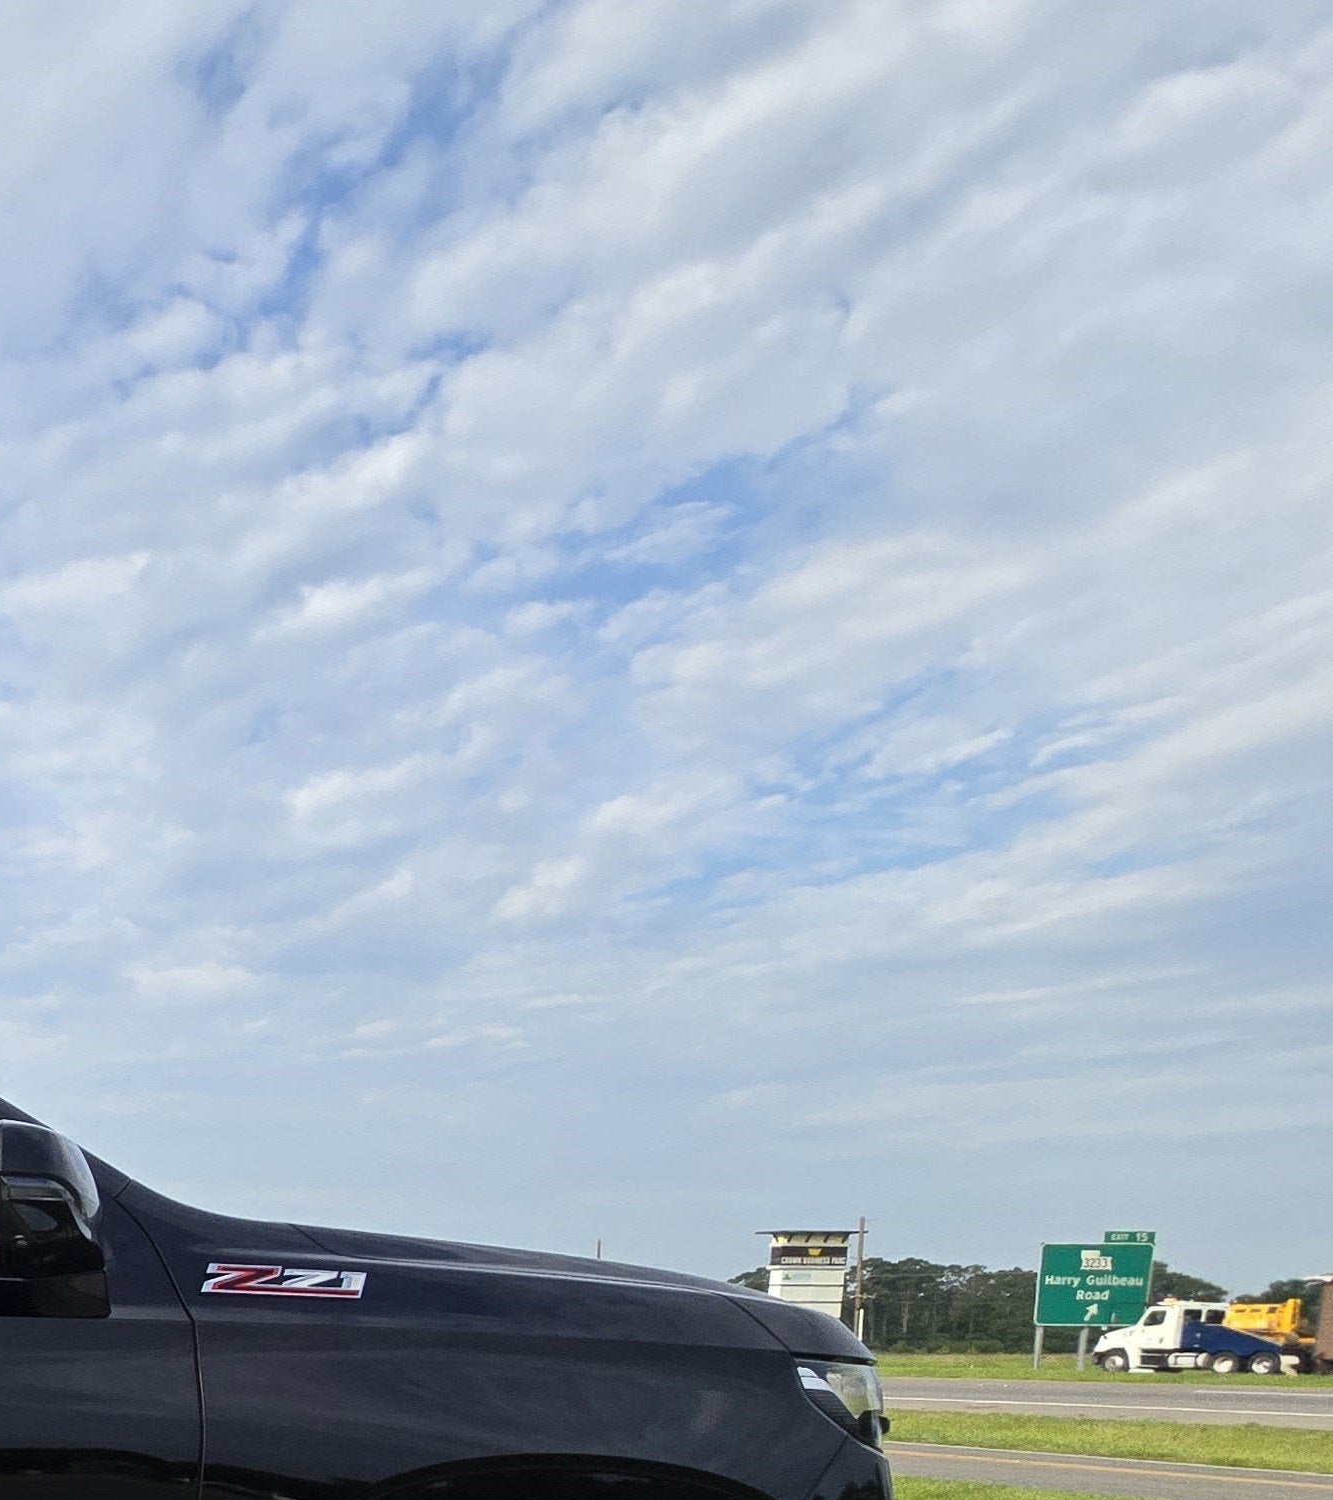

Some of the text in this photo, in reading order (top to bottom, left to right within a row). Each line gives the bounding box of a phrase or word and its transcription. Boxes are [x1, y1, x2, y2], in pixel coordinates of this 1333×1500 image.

[1135, 1232, 1149, 1242] 15
[201, 1263, 367, 1298] Z71
[1045, 1274, 1144, 1288] Harry Guilbeau
[1076, 1289, 1110, 1301] Road
